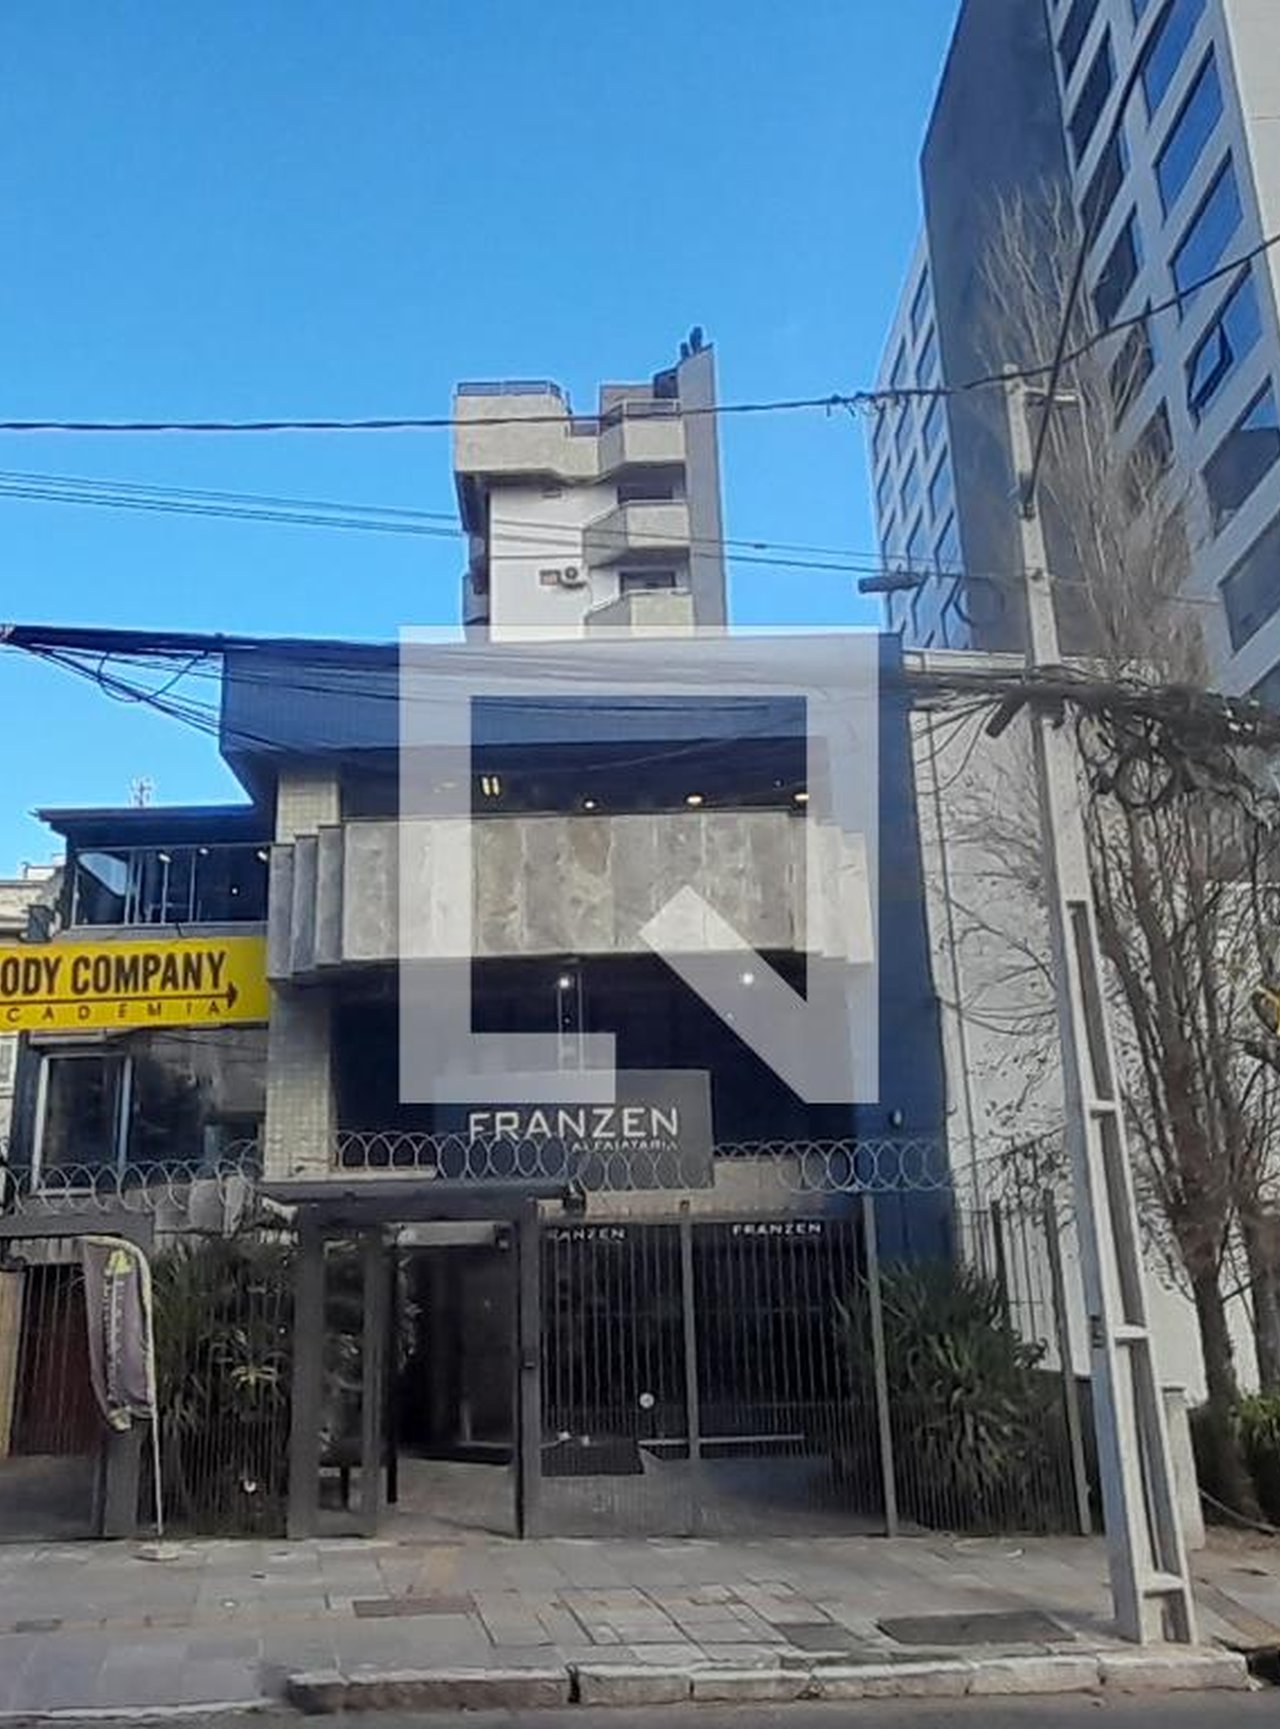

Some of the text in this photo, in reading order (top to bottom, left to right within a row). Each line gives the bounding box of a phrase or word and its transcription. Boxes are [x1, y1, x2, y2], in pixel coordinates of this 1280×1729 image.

[71, 951, 227, 995] COMPANY
[469, 1107, 679, 1143] FRANZEN
[732, 1223, 822, 1236] FRANZEN
